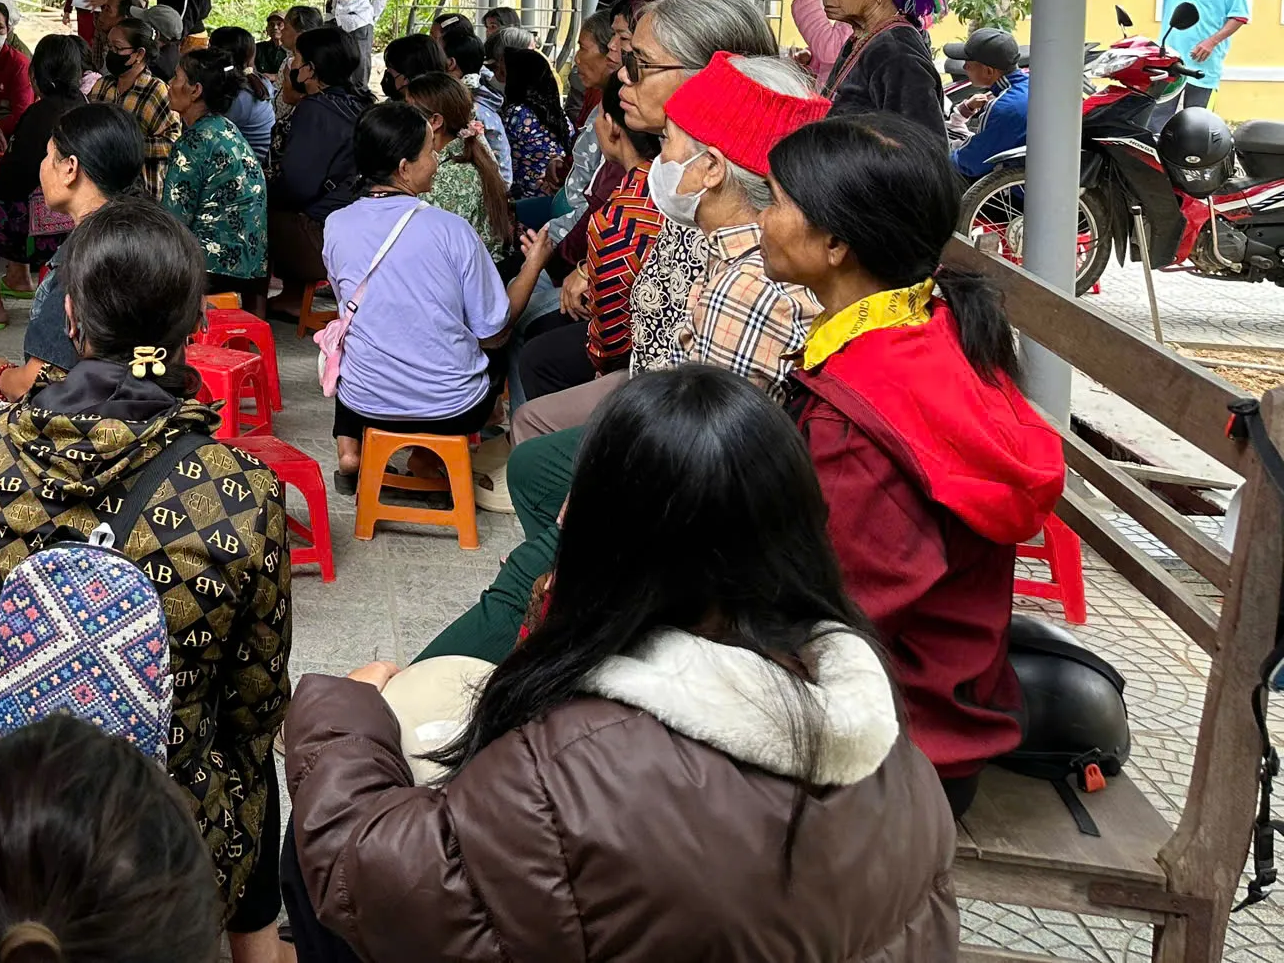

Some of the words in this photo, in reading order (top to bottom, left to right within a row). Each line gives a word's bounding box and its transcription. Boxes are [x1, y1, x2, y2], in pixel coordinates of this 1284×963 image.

[1129, 140, 1154, 153] HONDA
[204, 449, 234, 471] AB
[221, 477, 251, 503] AB
[151, 506, 188, 530] AB
[206, 528, 240, 555] AB
[143, 560, 174, 585] AB
[195, 576, 226, 598] AB
[271, 598, 287, 625] AB
[183, 629, 213, 648] AB
[236, 641, 252, 662] B
[175, 668, 201, 688] AB
